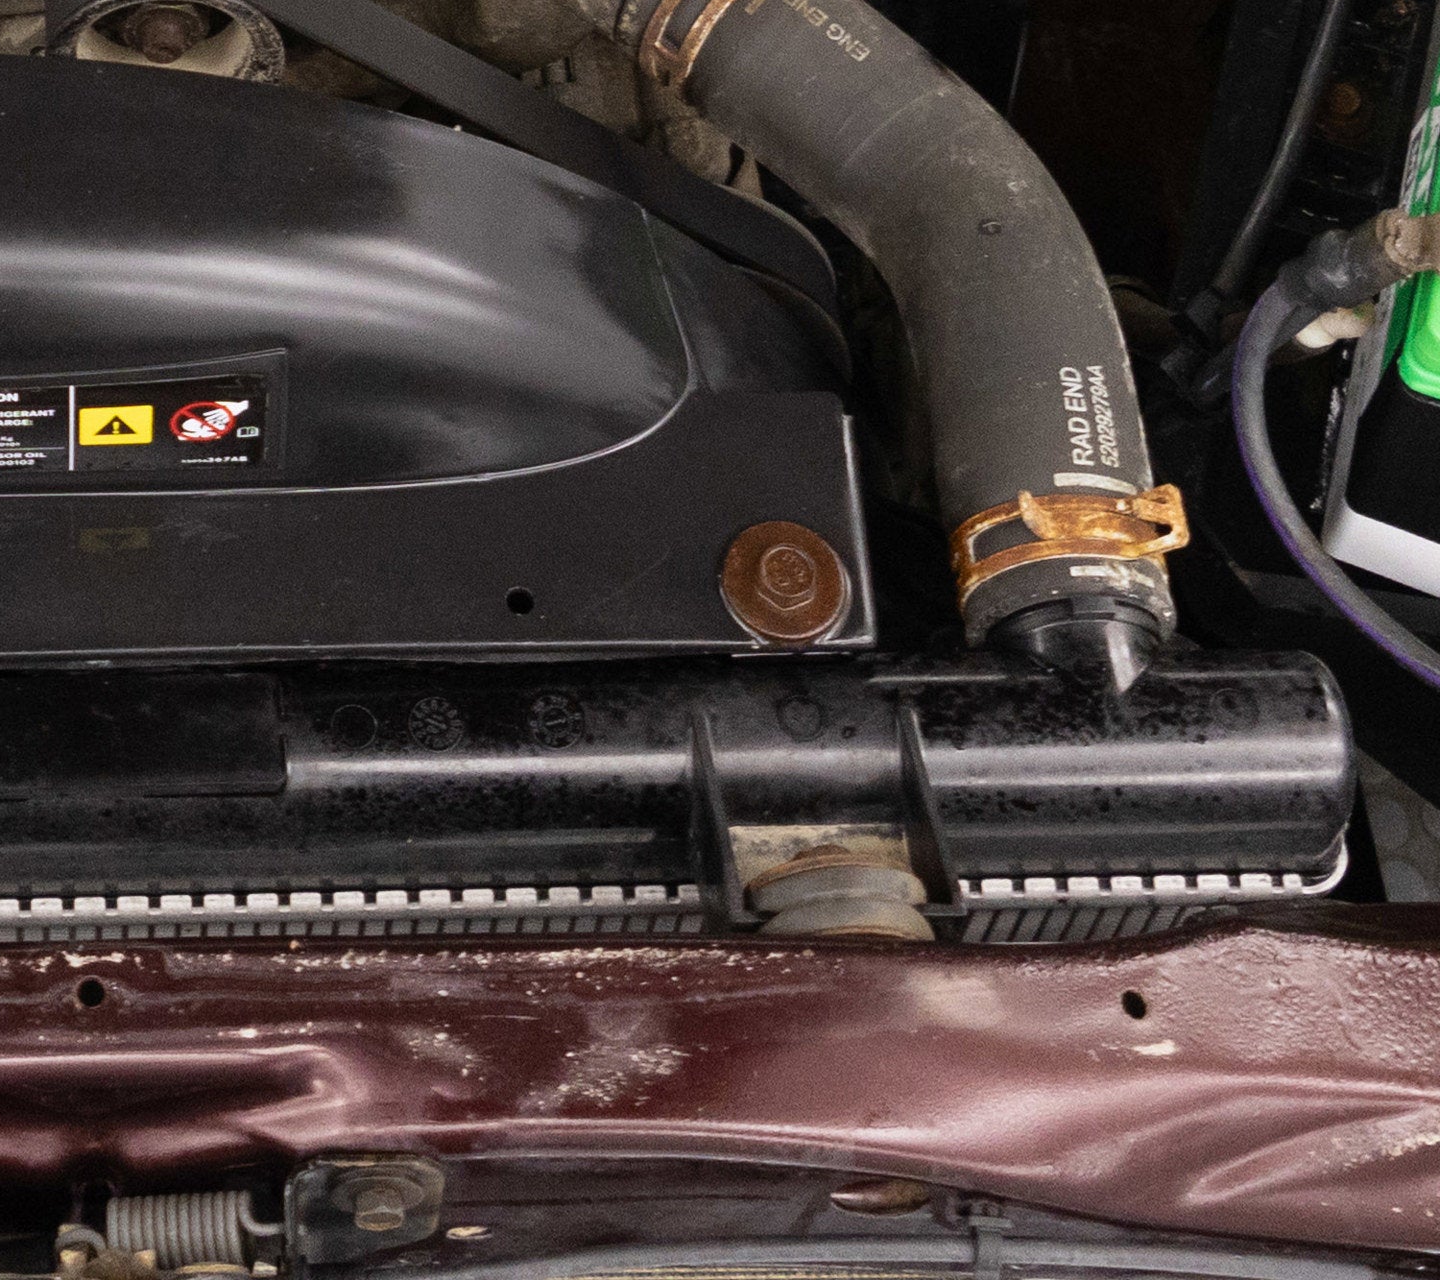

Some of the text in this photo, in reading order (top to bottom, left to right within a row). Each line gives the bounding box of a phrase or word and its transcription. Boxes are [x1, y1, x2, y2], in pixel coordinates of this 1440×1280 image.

[825, 22, 871, 62] ENG
[1058, 366, 1096, 467] RAD END
[1088, 364, 1121, 469] 52029279AA
